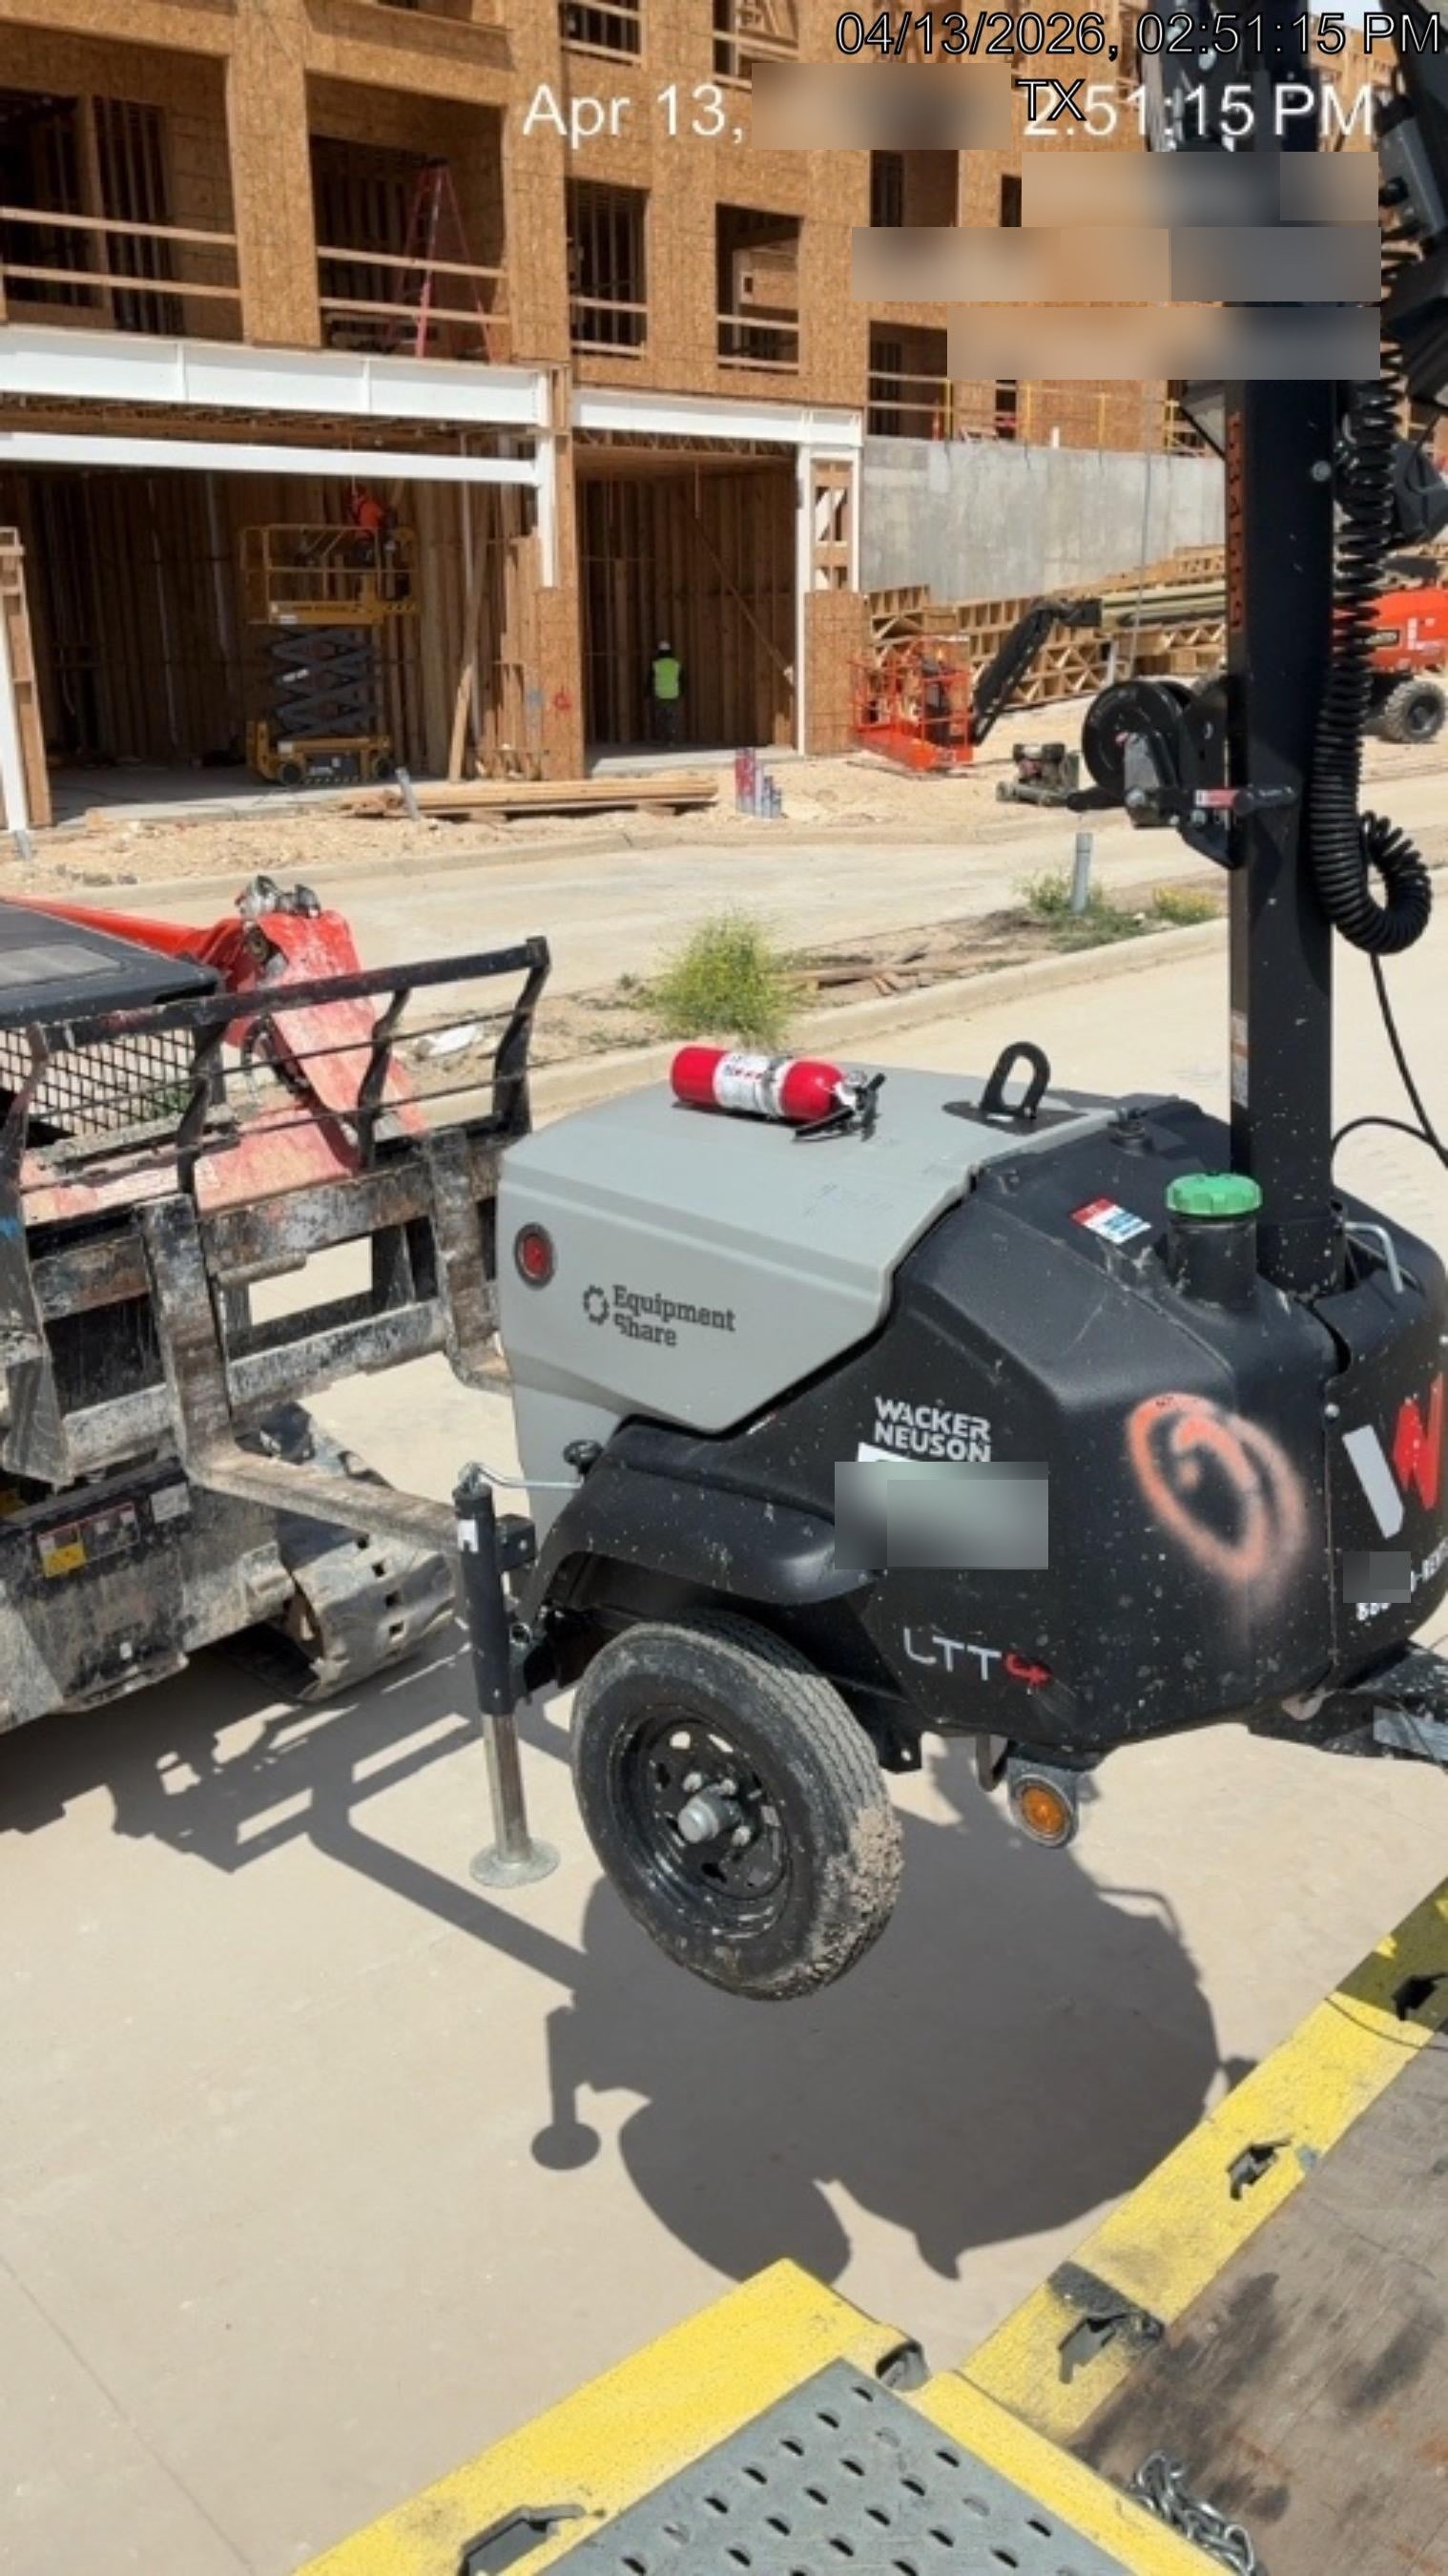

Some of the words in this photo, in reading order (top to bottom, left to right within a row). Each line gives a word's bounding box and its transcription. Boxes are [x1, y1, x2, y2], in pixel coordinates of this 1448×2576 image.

[611, 1284, 737, 1333] Equipment
[612, 1312, 677, 1347] Share
[874, 1395, 991, 1443] WACKER
[874, 1419, 992, 1463] NEUSON
